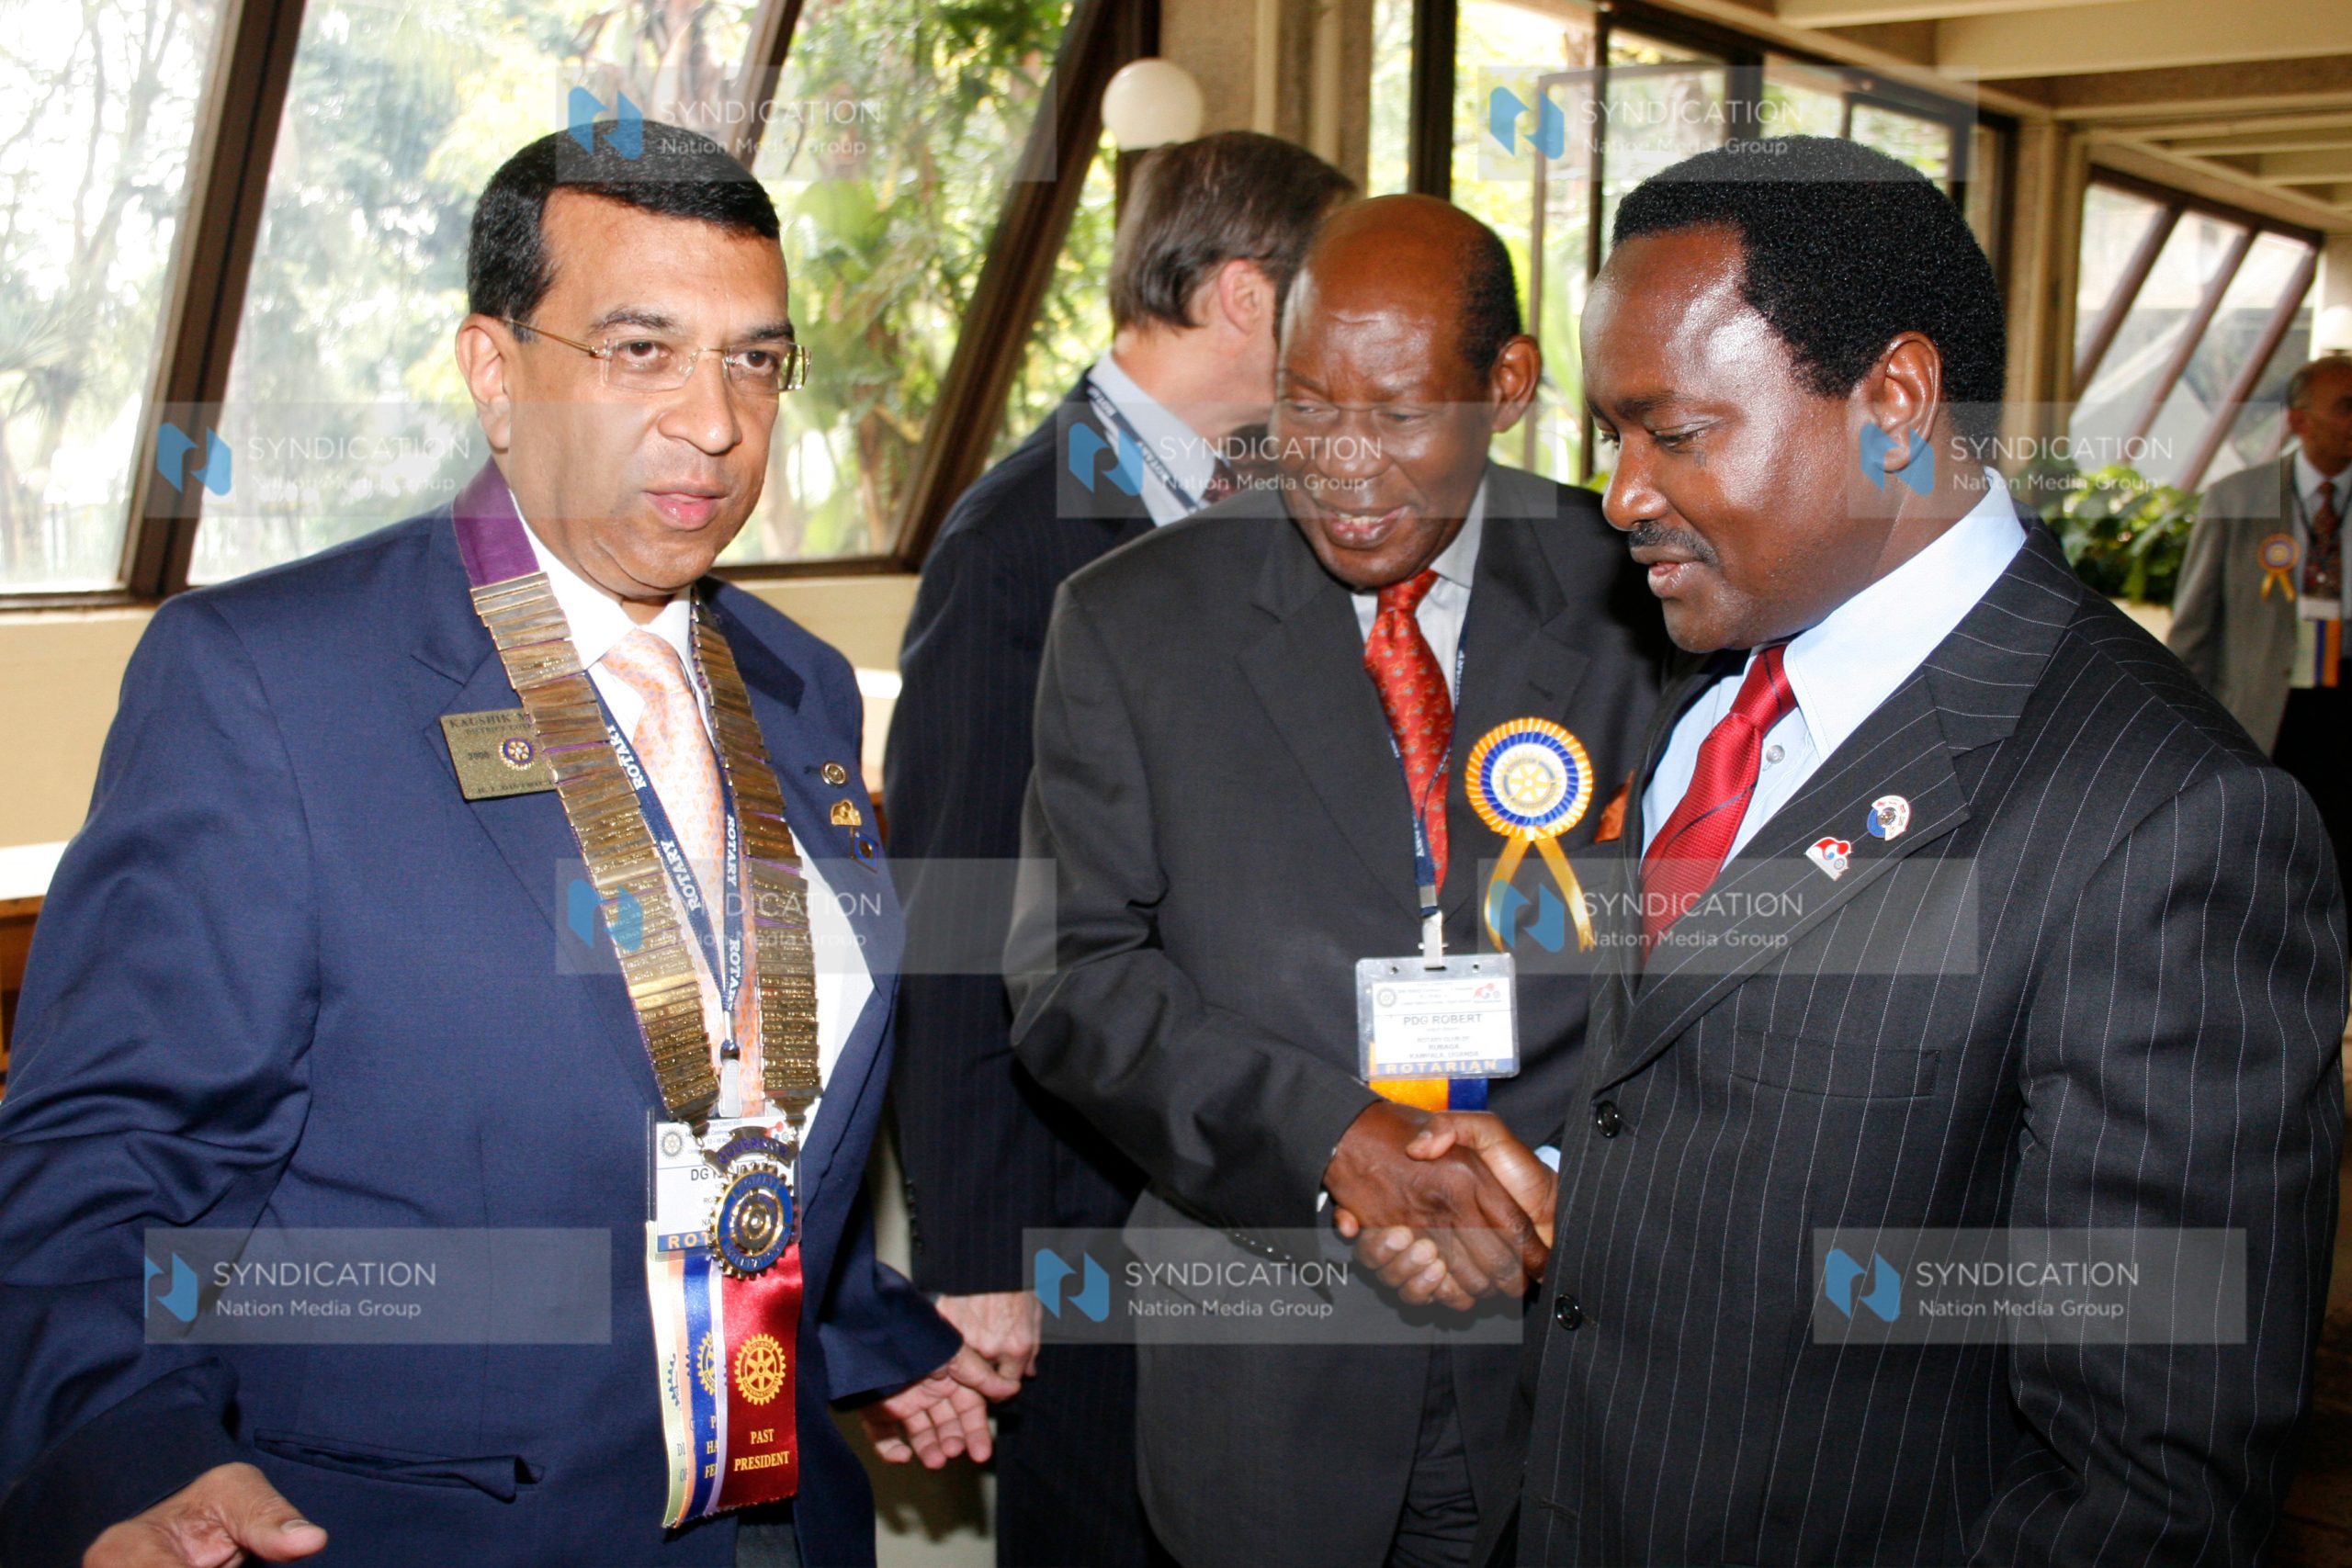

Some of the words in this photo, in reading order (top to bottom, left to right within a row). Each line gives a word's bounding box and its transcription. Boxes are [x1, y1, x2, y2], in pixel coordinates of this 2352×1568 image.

[727, 814, 737, 886] ROTARY
[661, 840, 702, 911] ROTARY
[1403, 1016, 1429, 1026] PDG
[1431, 1013, 1483, 1024] ROBERT
[1385, 1060, 1497, 1074] ROTARIAN
[691, 1168, 709, 1180] DG
[750, 1428, 775, 1445] PAST
[733, 1450, 790, 1472] PRESIDENT
